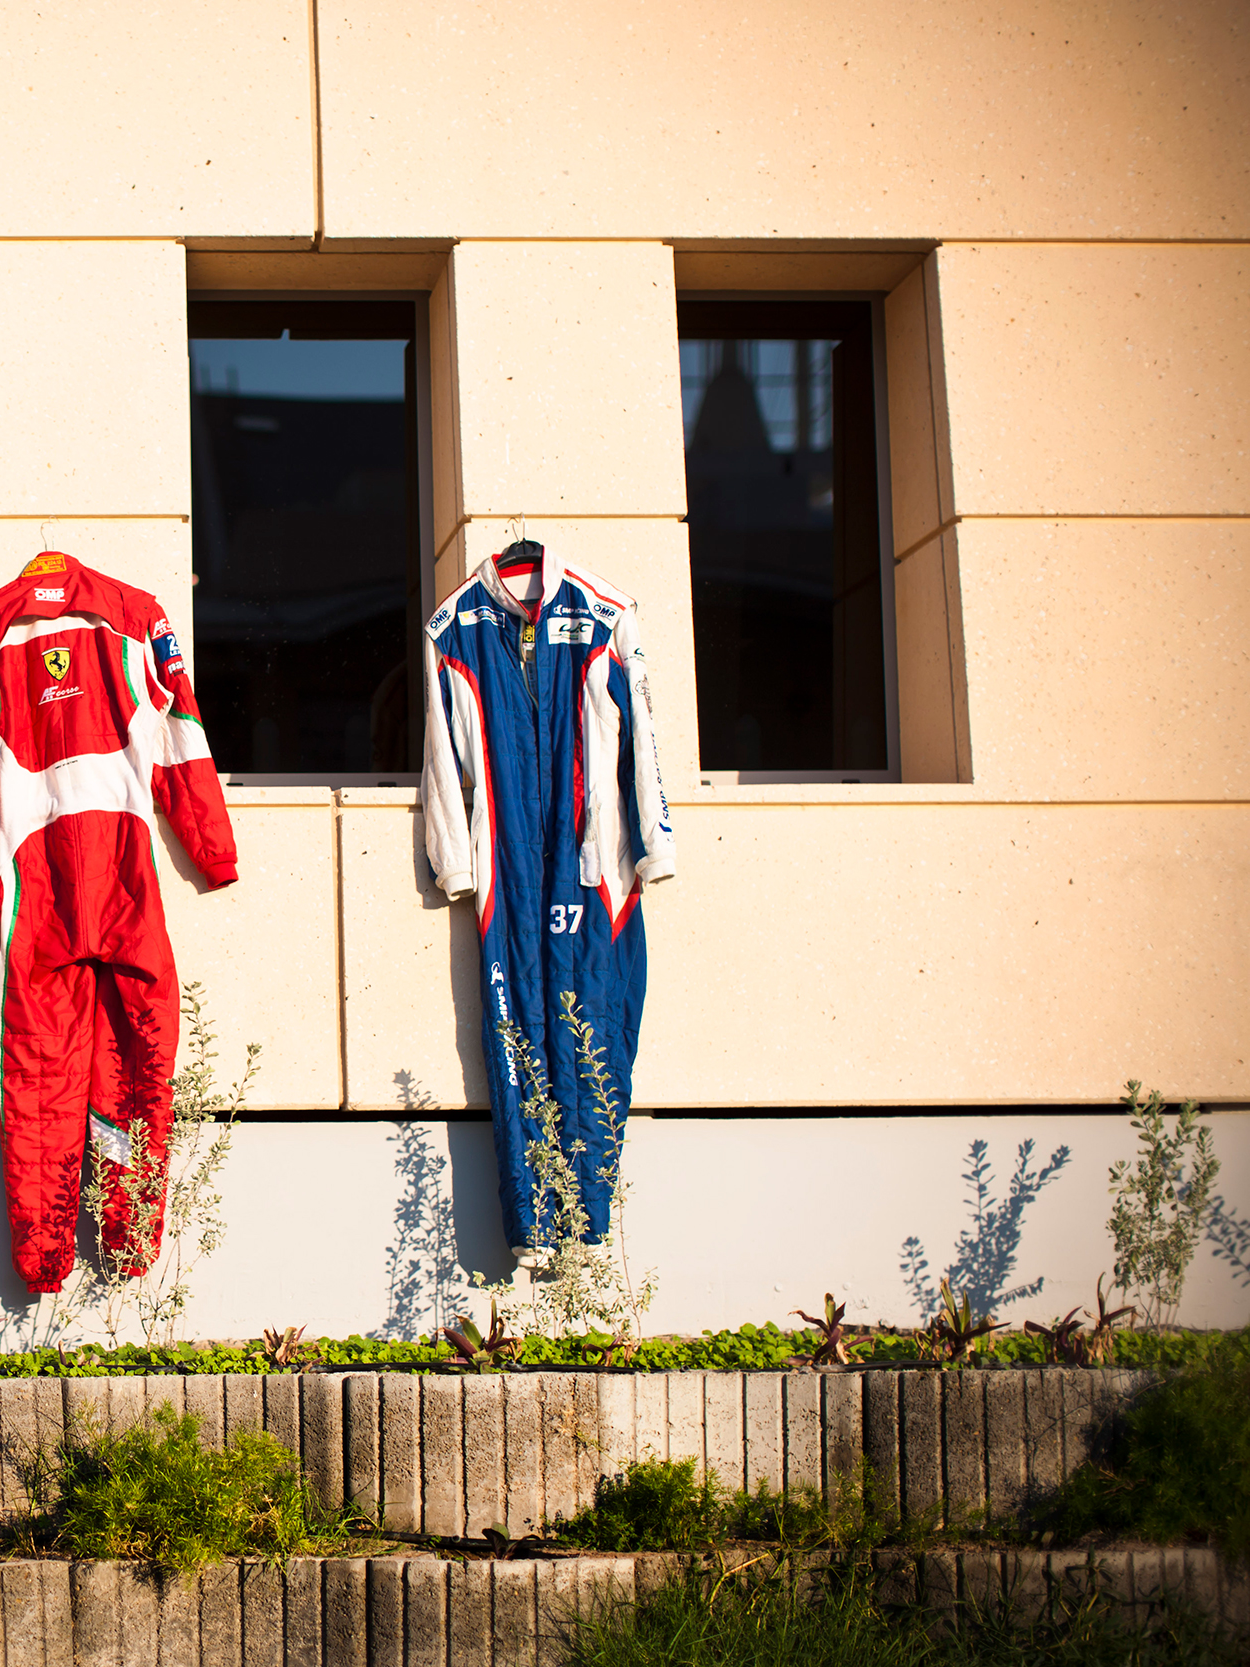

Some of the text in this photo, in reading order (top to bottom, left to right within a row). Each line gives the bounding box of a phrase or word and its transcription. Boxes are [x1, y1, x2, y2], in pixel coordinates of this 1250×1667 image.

[34, 589, 65, 600] OMP
[593, 604, 616, 617] OMP
[429, 609, 449, 629] OMP
[56, 686, 80, 697] corse
[549, 904, 584, 934] 37
[502, 1027, 519, 1087] CING
